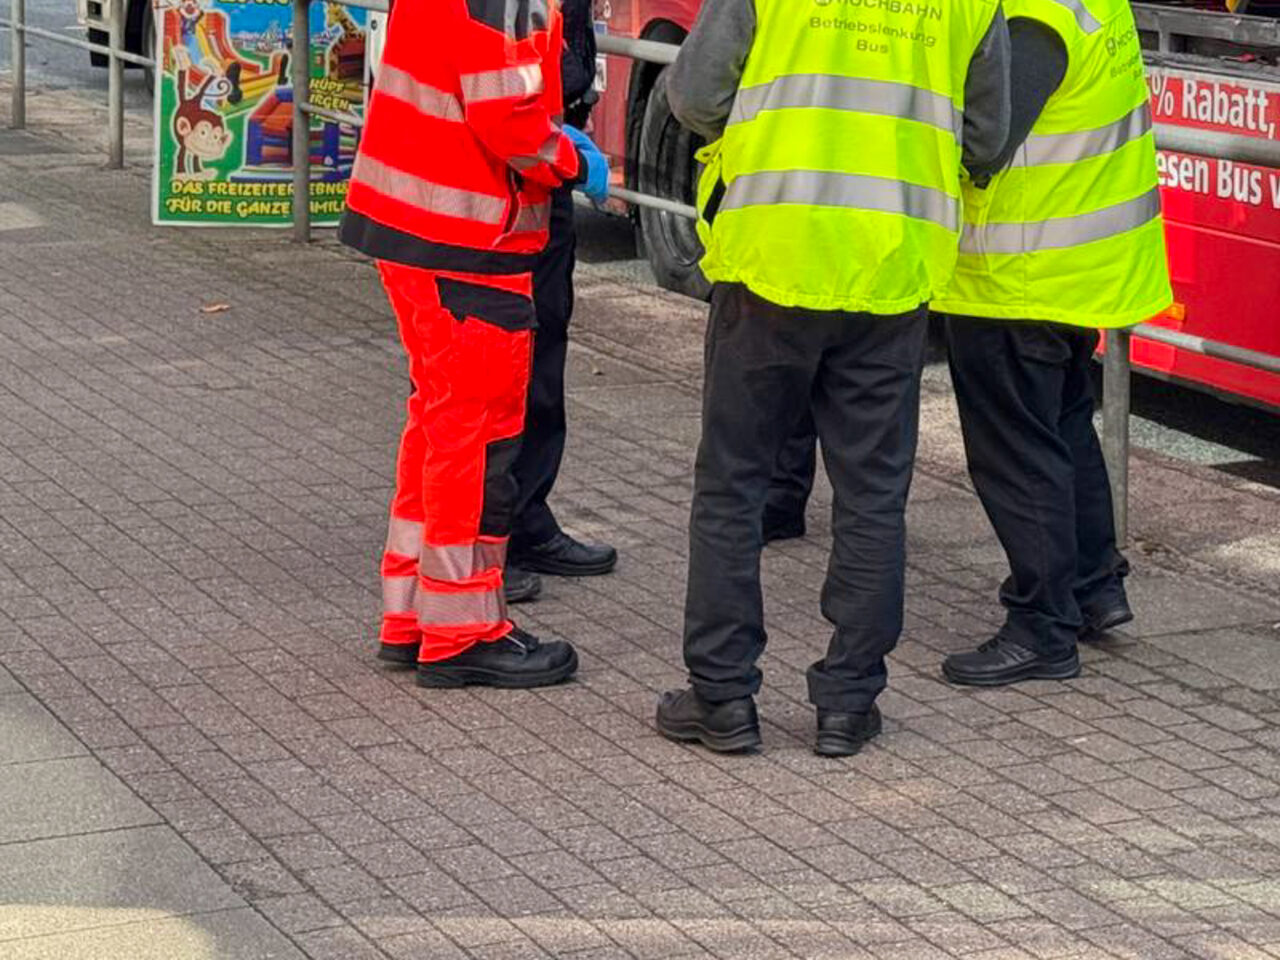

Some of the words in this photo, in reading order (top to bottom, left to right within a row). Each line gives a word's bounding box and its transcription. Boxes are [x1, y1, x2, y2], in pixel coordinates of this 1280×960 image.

[809, 17, 936, 48] Betriebslenkung
[856, 39, 889, 54] Bus
[1182, 78, 1276, 140] Rabatt,
[172, 182, 204, 195] DAS
[1216, 158, 1262, 206] Bus
[166, 197, 203, 213] FÜR
[206, 200, 232, 213] DIE
[237, 200, 291, 218] GANZE
